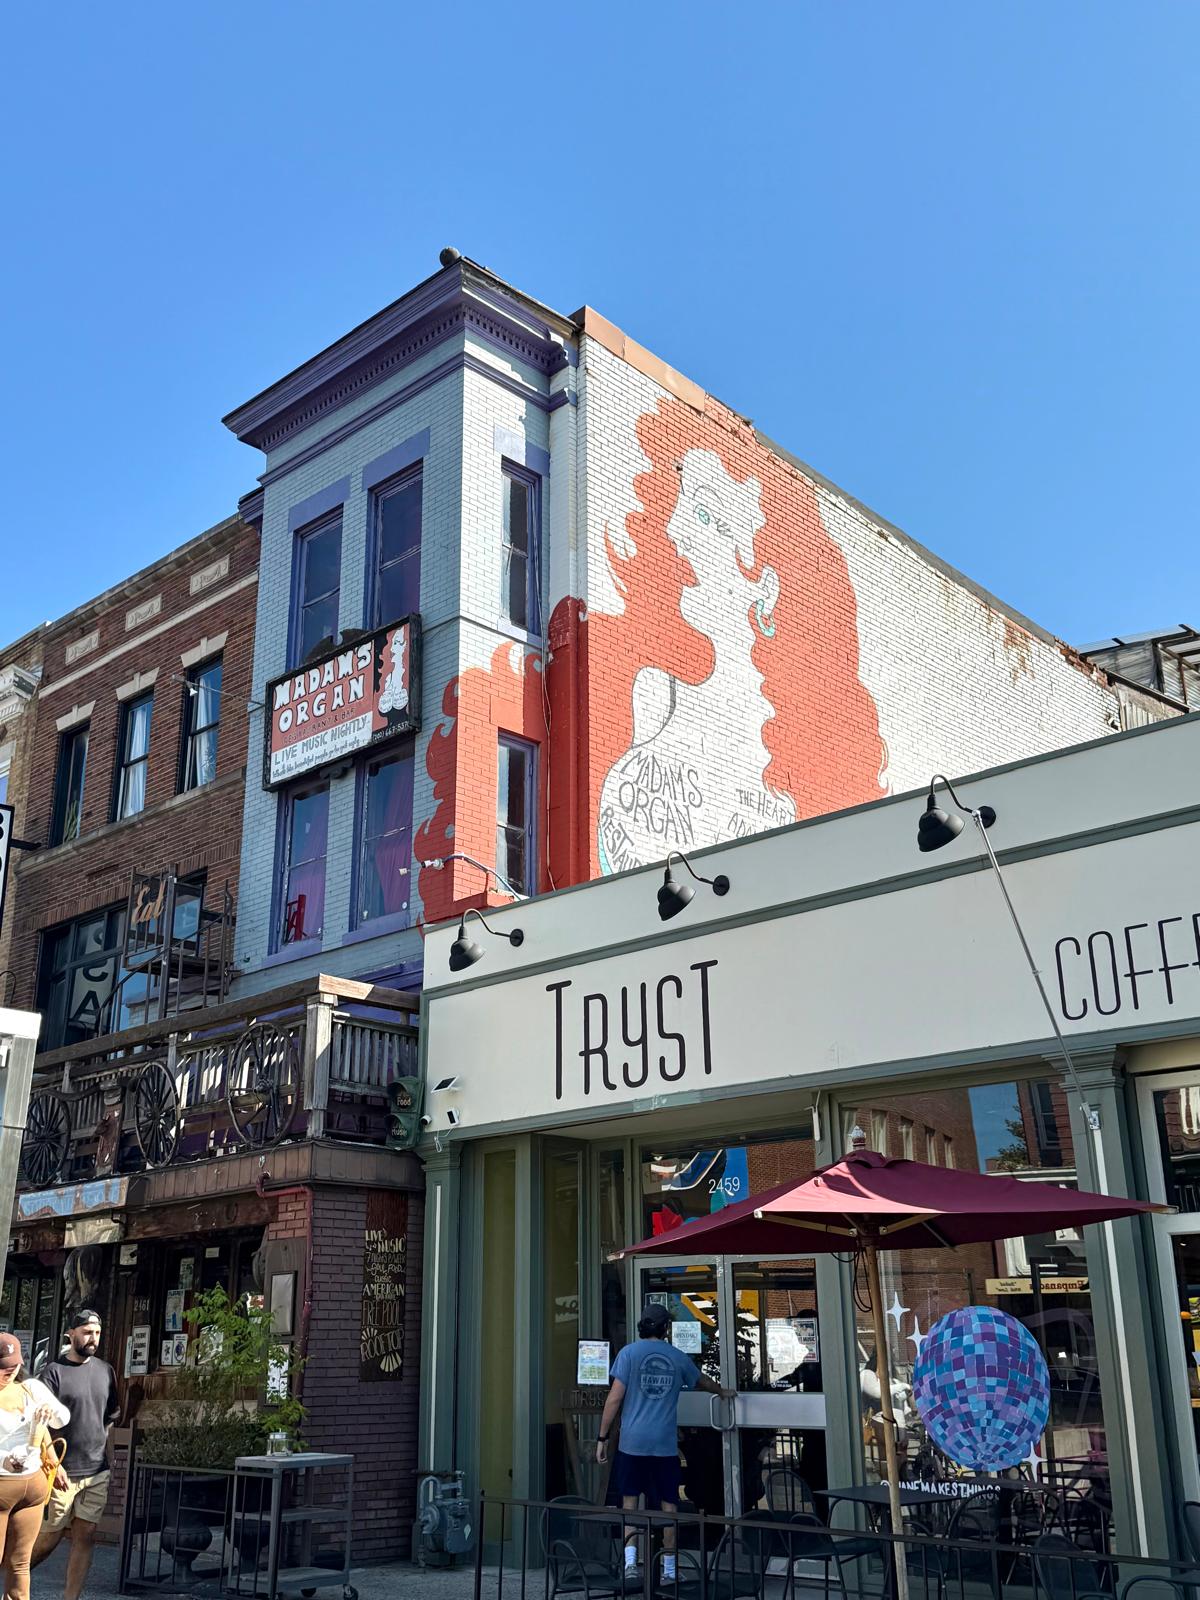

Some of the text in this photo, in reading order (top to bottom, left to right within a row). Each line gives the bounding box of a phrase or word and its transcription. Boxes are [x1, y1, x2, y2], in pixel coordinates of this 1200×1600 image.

[274, 641, 373, 711] MADAM'S
[278, 674, 366, 733] ORGAN
[274, 716, 368, 765] LIVE MUSIC NIGHTLY
[620, 750, 703, 808] MADAM'S
[735, 788, 755, 808] THE
[619, 781, 695, 846] ORGAN
[131, 879, 166, 924] Eat
[708, 1176, 740, 1194] 2459
[365, 1230, 383, 1241] LIVE
[377, 1237, 407, 1253] MUSIC
[362, 1283, 405, 1297] AMERICAN
[362, 1300, 405, 1325] FREE POOL
[643, 1375, 672, 1385] HAWAII
